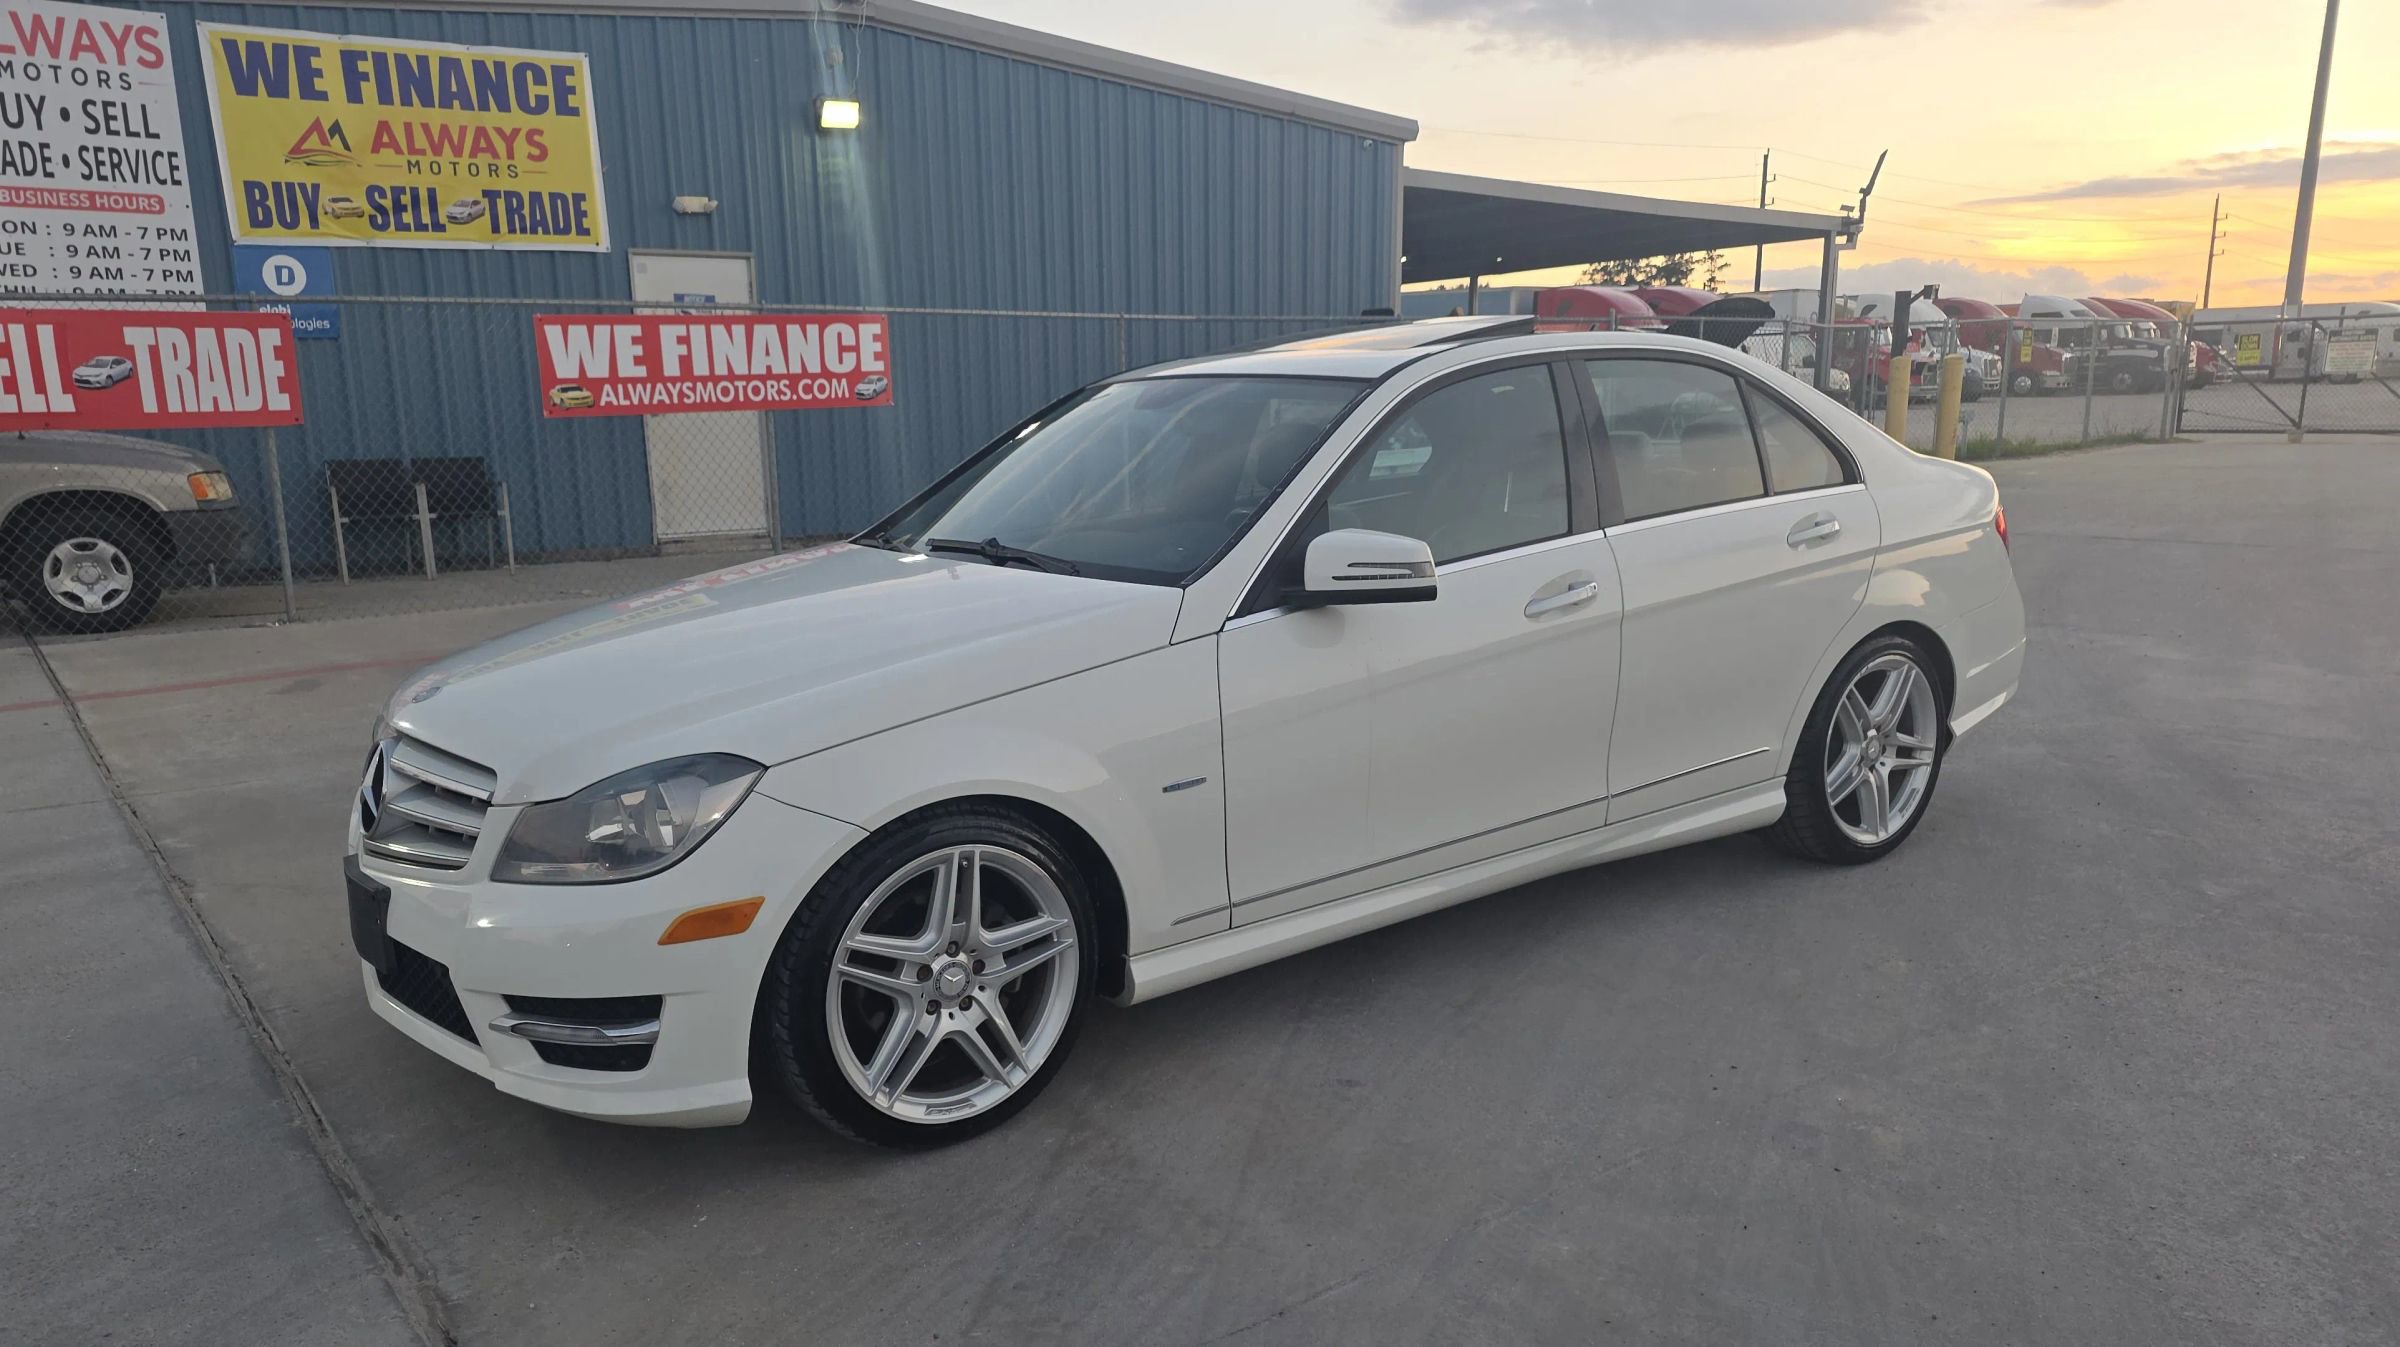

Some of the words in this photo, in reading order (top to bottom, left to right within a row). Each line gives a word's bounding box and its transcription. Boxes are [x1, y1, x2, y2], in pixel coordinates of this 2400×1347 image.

[0, 60, 132, 91] MOTORS
[220, 38, 329, 101] WE
[339, 49, 580, 117] FINANCE
[82, 98, 161, 140] SELL
[370, 120, 549, 163] ALWAYS
[0, 139, 55, 179] ADE
[78, 144, 183, 186] SERVICE
[407, 160, 519, 178] MOTORS
[0, 188, 90, 208] BUSINESS
[95, 195, 161, 211] HOURS
[243, 180, 320, 230] BUY
[365, 184, 447, 233] SELL
[481, 189, 591, 236] TRADE
[63, 223, 75, 236] 9
[83, 224, 118, 238] AM
[136, 227, 148, 240] 7
[156, 228, 188, 241] PM
[66, 245, 78, 258] 9
[86, 246, 121, 259] AM
[139, 248, 151, 261] 7
[159, 249, 191, 262] PM
[69, 266, 82, 279] 9
[89, 267, 124, 280] AM
[142, 269, 154, 282] 7
[162, 269, 194, 283] PM
[544, 324, 647, 379] WE
[659, 322, 885, 377] FINANCE
[123, 326, 291, 413] TRADE
[599, 378, 850, 407] ALWAYSMOTORS.COM
